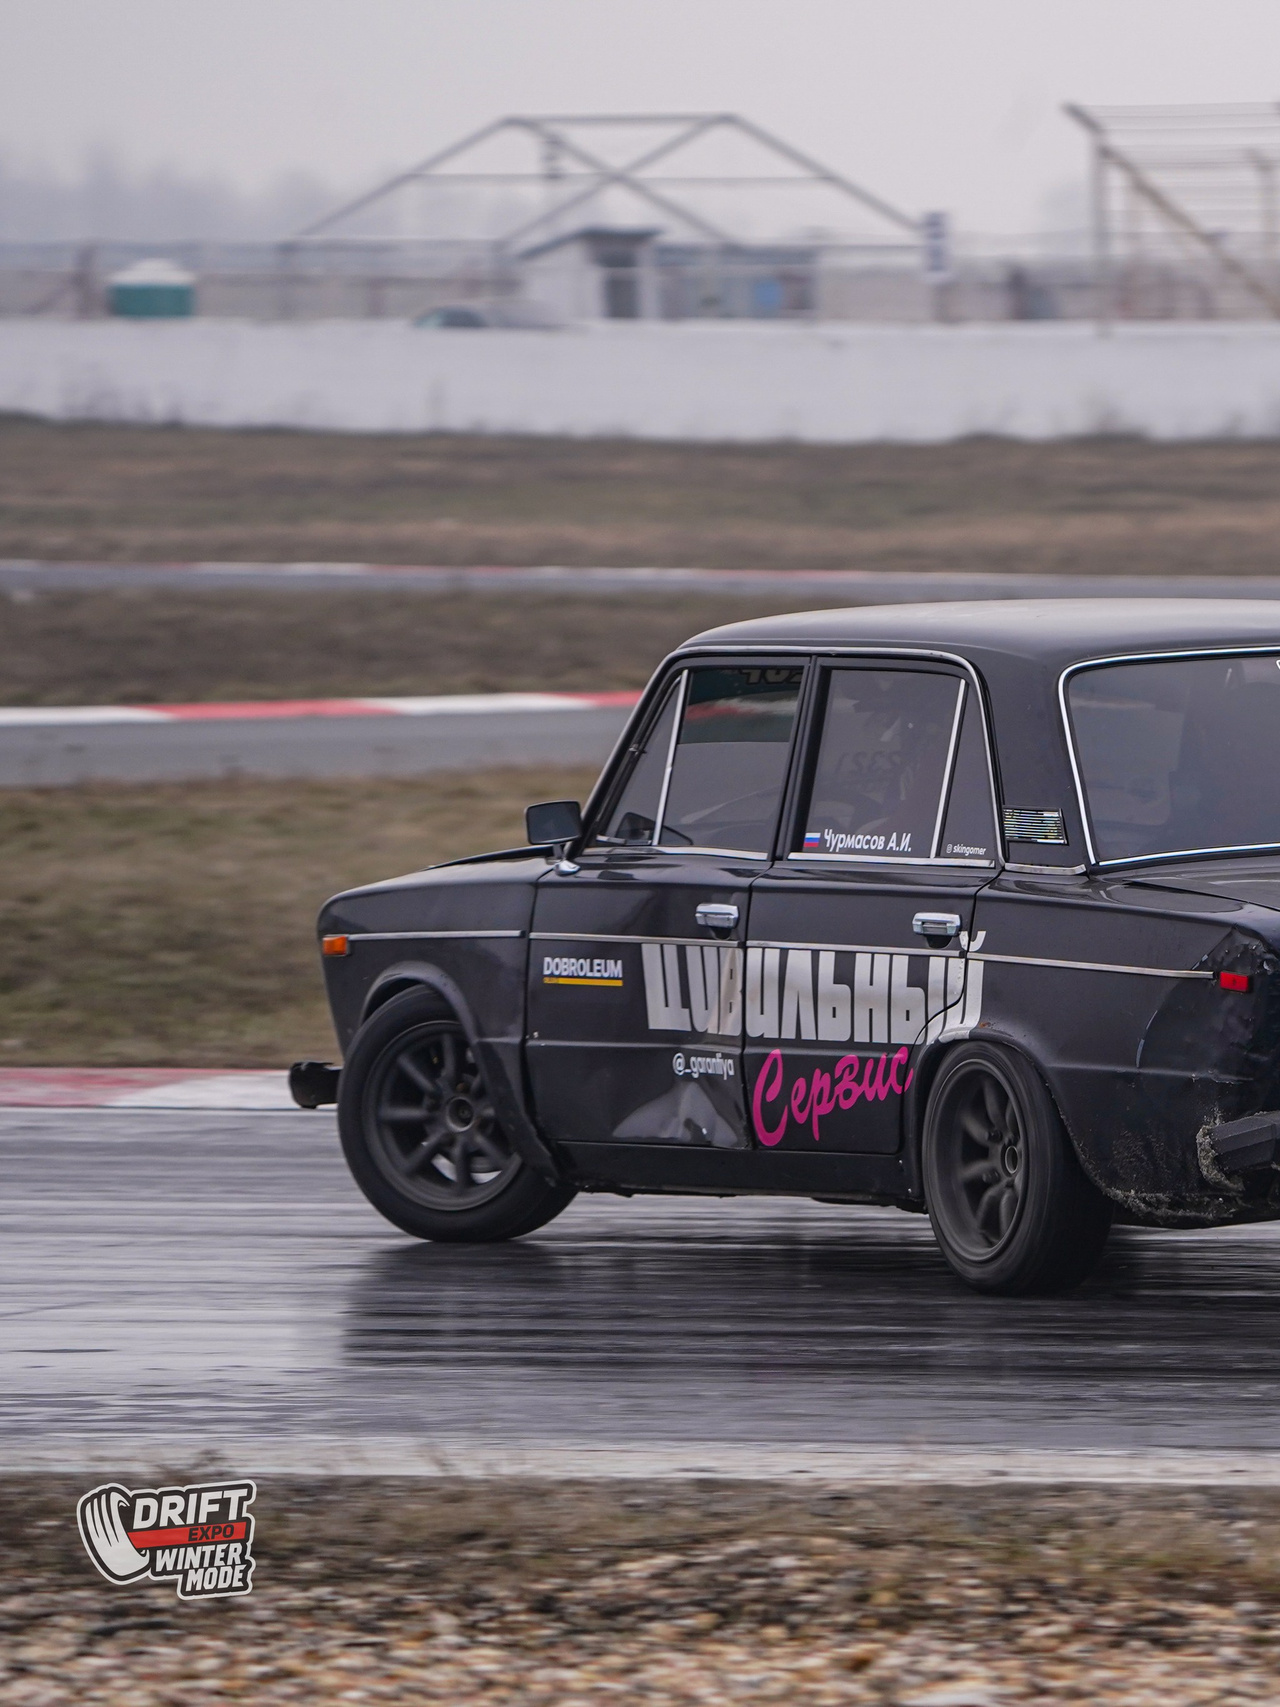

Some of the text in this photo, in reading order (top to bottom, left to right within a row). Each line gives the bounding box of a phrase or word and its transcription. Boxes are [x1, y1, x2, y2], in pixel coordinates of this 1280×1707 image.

[823, 828, 912, 853] Чурмасов А.И.
[543, 957, 623, 978] DOBROLEUM
[753, 1046, 914, 1146] Сервис
